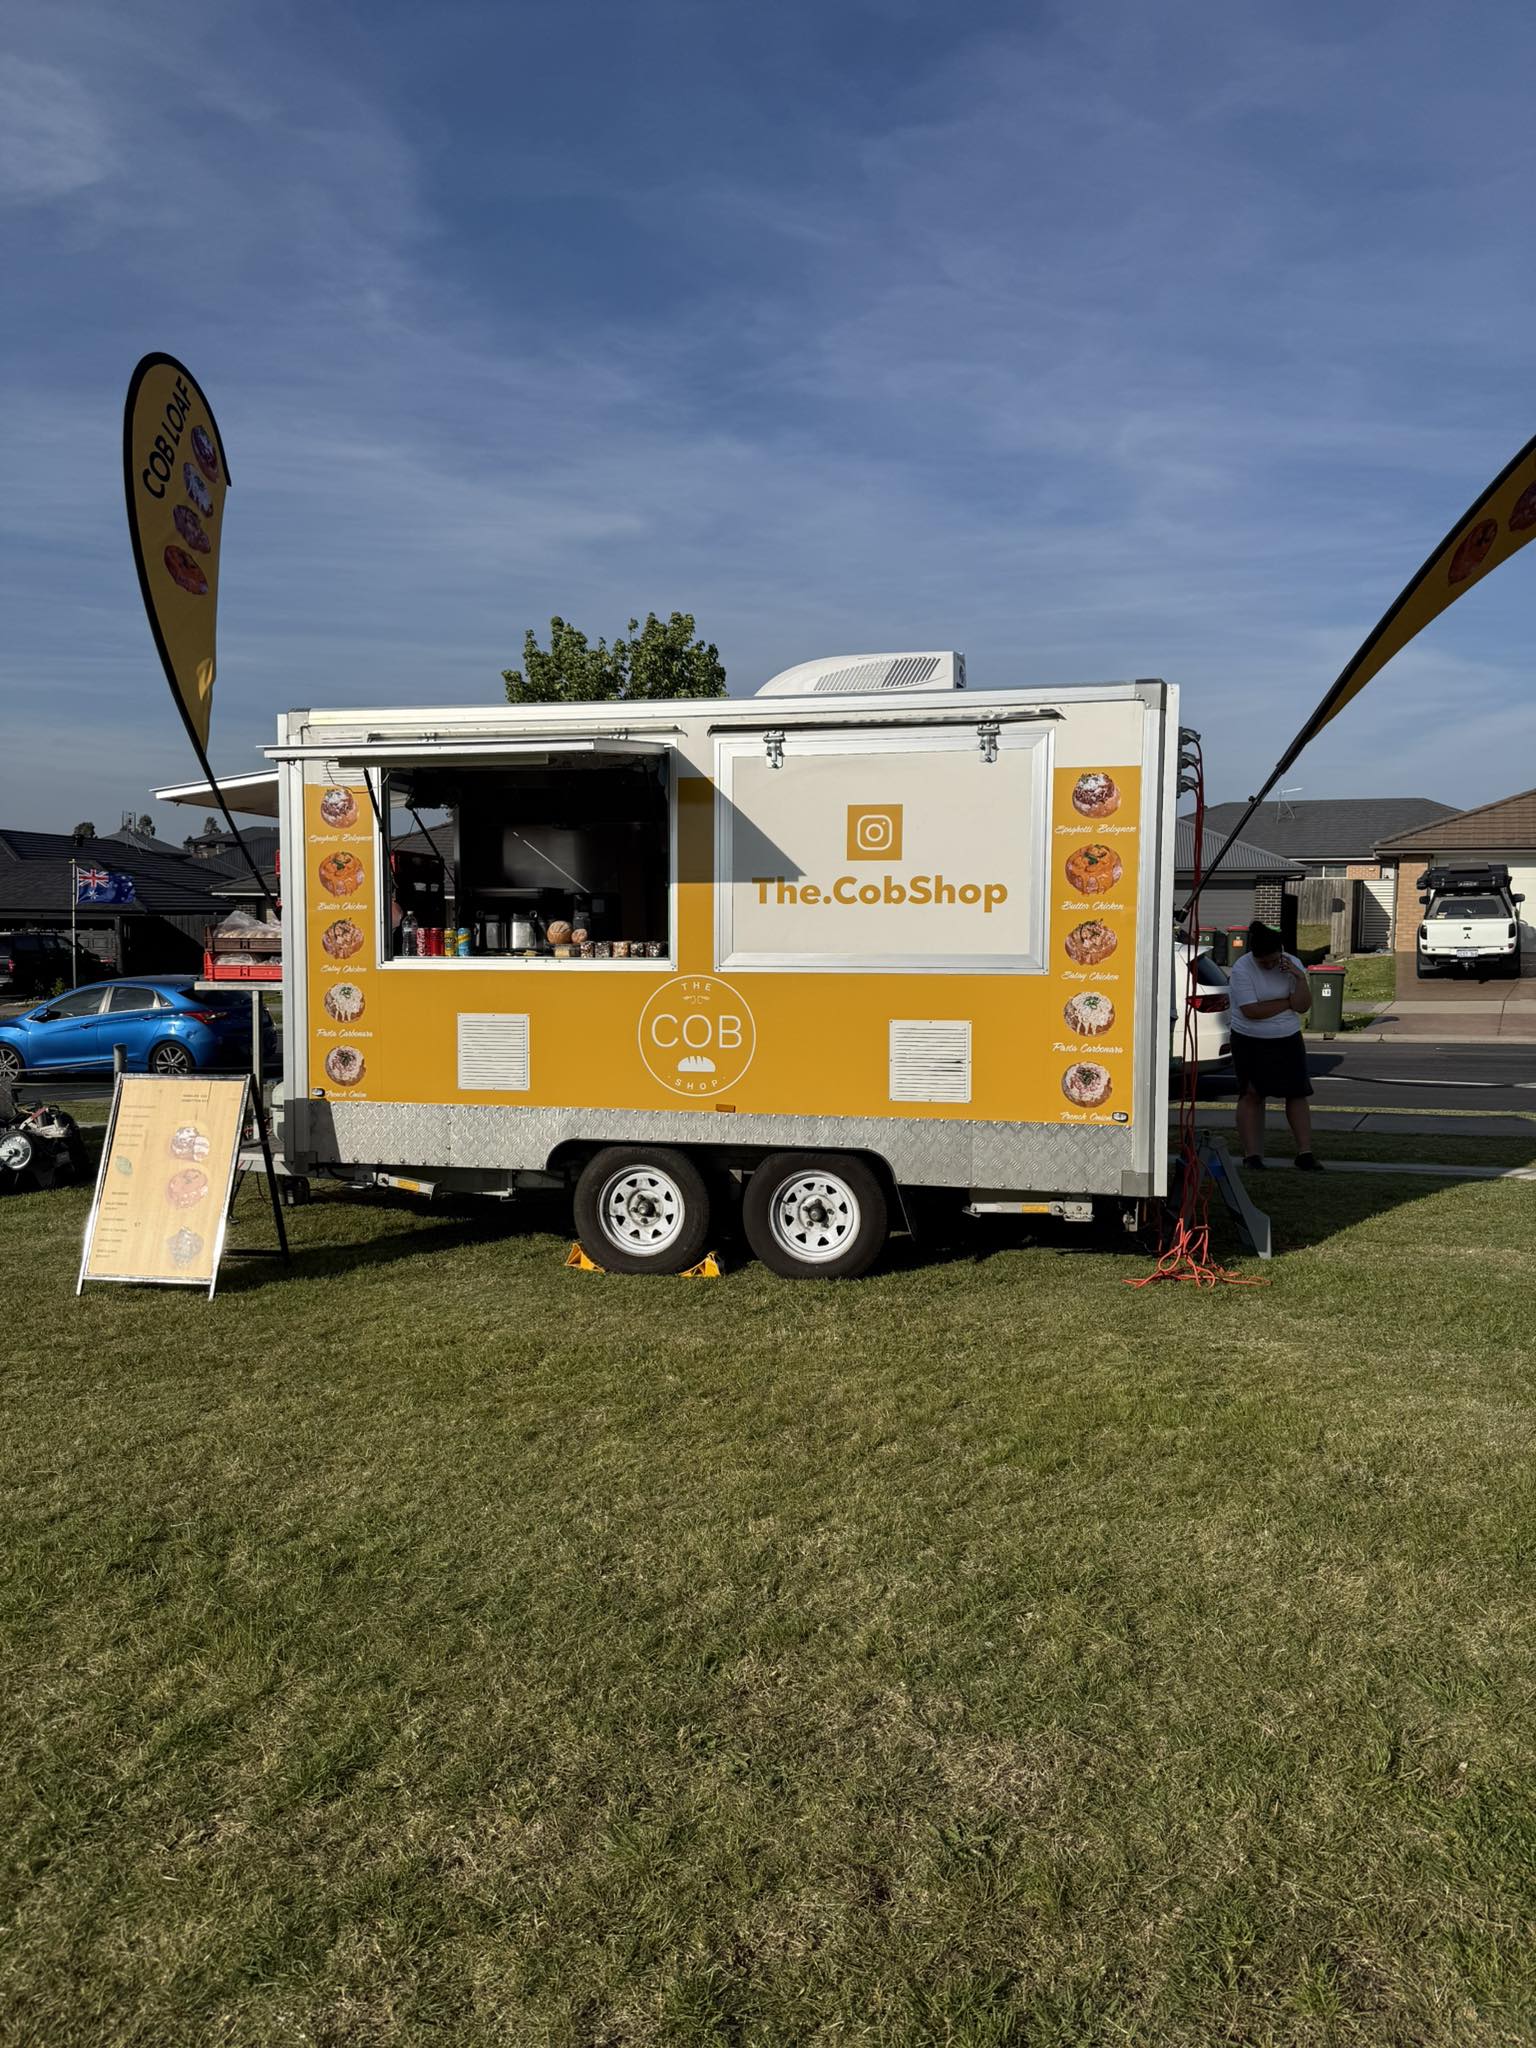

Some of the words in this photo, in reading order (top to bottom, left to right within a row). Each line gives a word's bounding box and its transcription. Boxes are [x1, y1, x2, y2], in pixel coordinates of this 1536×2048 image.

[142, 434, 175, 499] COB
[161, 376, 191, 447] LOAF
[1055, 824, 1093, 836] Spaghetti
[1097, 823, 1136, 836] Bolognese
[751, 875, 1008, 913] The.CobShop
[342, 902, 368, 911] Chicken
[1060, 900, 1089, 911] Butter
[1092, 901, 1124, 911] Chicken
[342, 965, 367, 973] Chicken
[1089, 971, 1119, 982] Chicken
[681, 982, 712, 991] THE
[651, 1014, 742, 1048] COB
[1052, 1042, 1078, 1052] Pasta
[1080, 1043, 1124, 1054] Carbonara
[675, 1079, 718, 1090] SHOP
[1060, 1111, 1087, 1121] French
